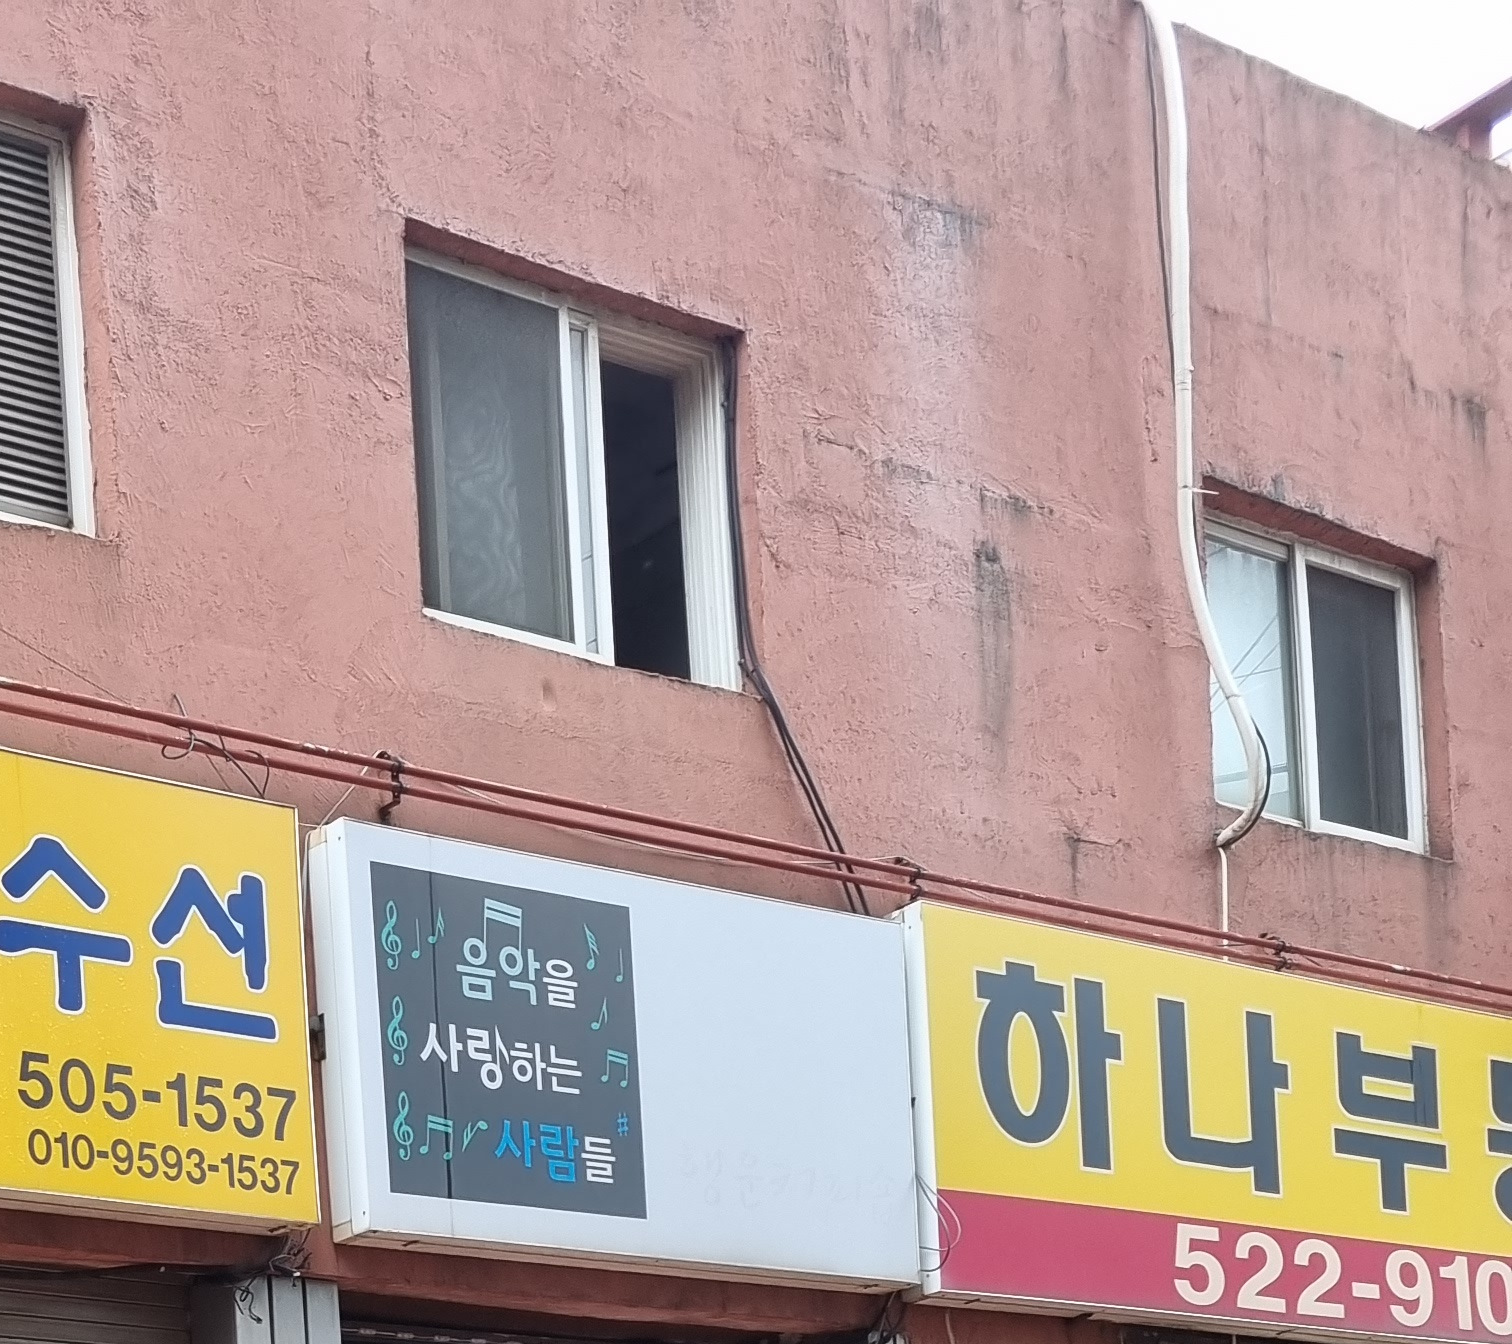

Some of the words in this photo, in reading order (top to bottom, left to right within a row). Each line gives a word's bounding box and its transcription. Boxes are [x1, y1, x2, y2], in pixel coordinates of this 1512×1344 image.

[455, 937, 579, 1009] 음악을
[419, 1022, 583, 1095] 사랑하는
[974, 960, 1512, 1228] 하나부
[16, 1050, 297, 1142] 505-1537
[27, 1127, 300, 1196] 010-9593-1537
[494, 1119, 617, 1184] 사람들
